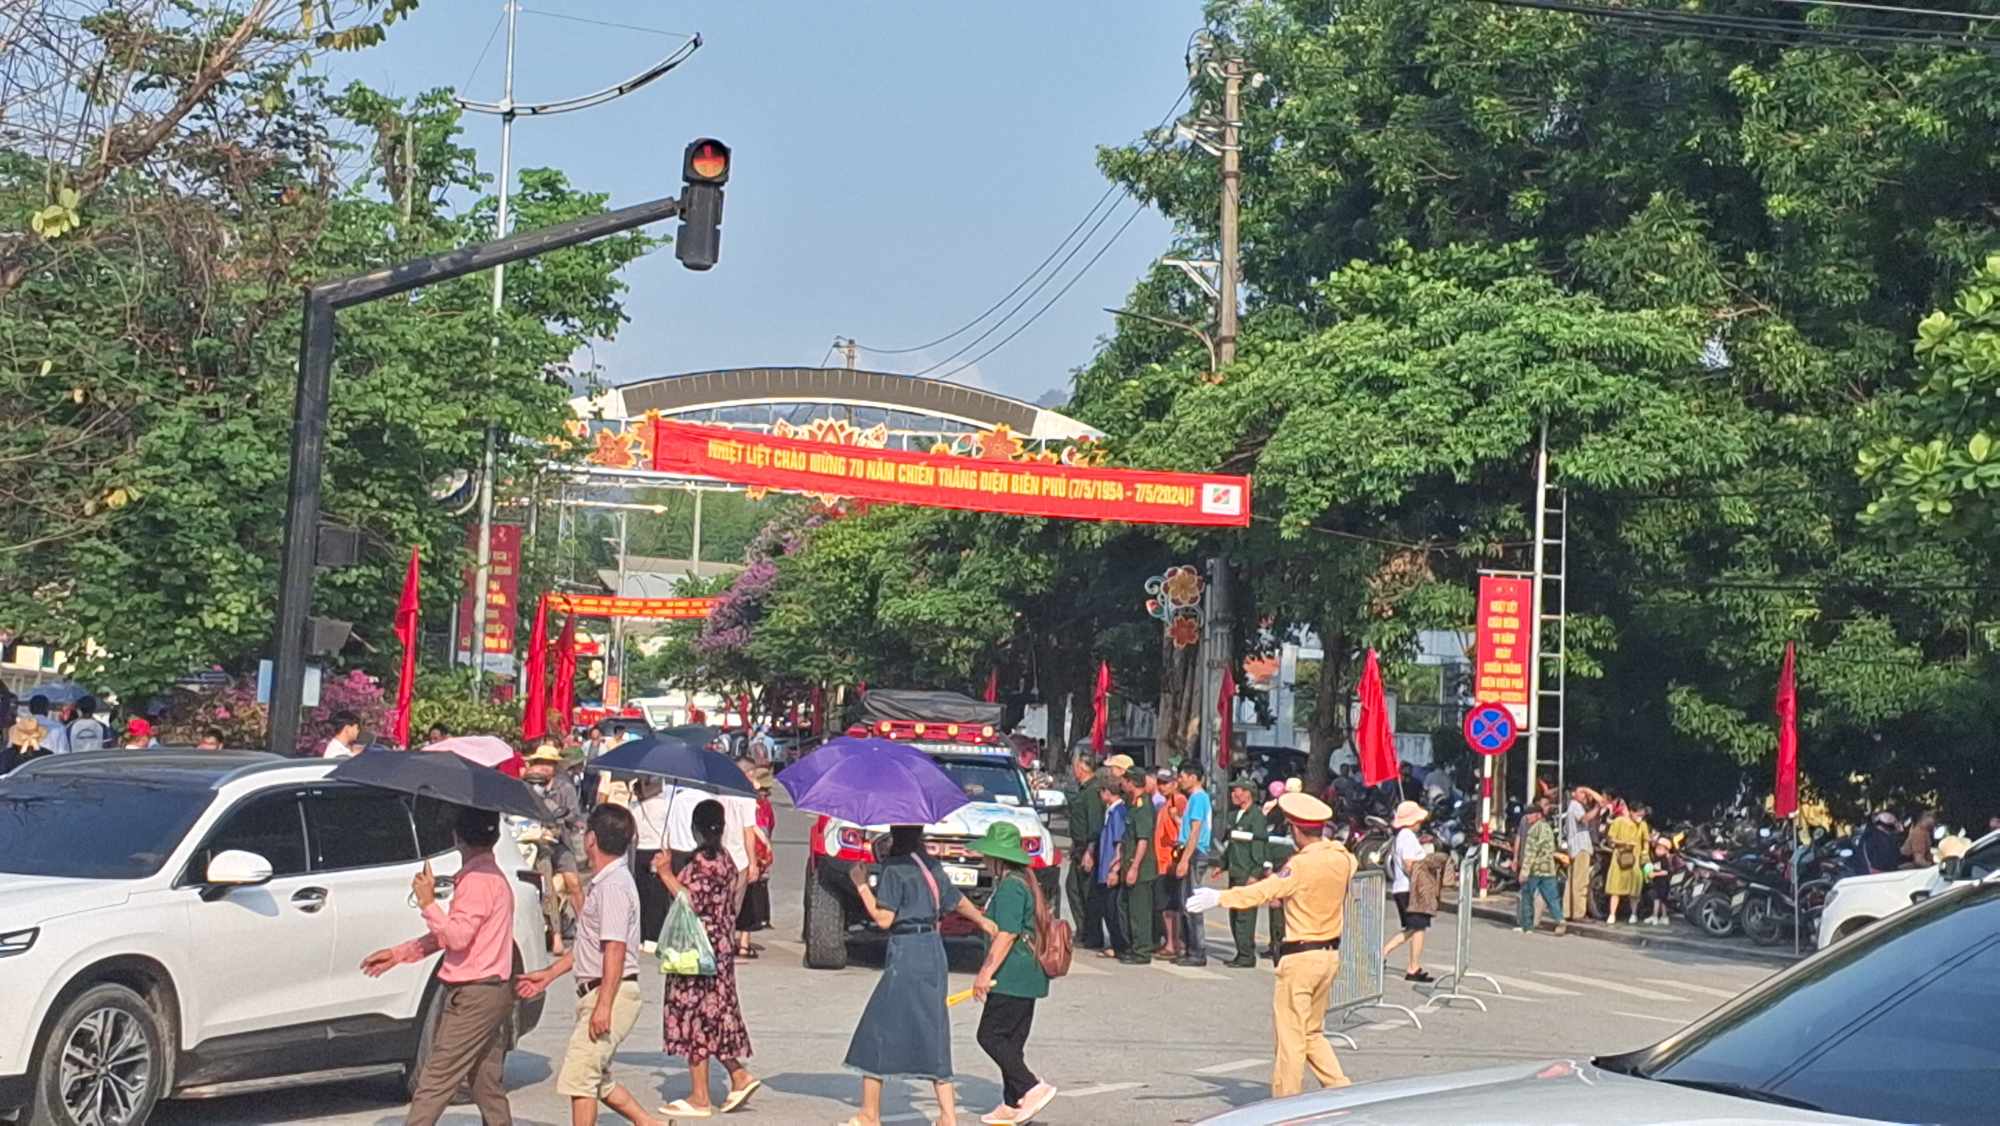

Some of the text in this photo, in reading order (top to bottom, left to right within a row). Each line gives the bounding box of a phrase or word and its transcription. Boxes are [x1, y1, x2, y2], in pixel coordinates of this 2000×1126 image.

[747, 445, 771, 468] LIỆT
[774, 449, 806, 471] CHÀO
[849, 459, 864, 477] 70
[867, 457, 895, 481] NĂM
[898, 461, 933, 485] CHIẾN
[938, 465, 977, 490] THẮNG
[1011, 472, 1039, 495] BIÊN
[1042, 474, 1065, 497] PHỦ
[1069, 479, 1123, 500] (7/5/1954
